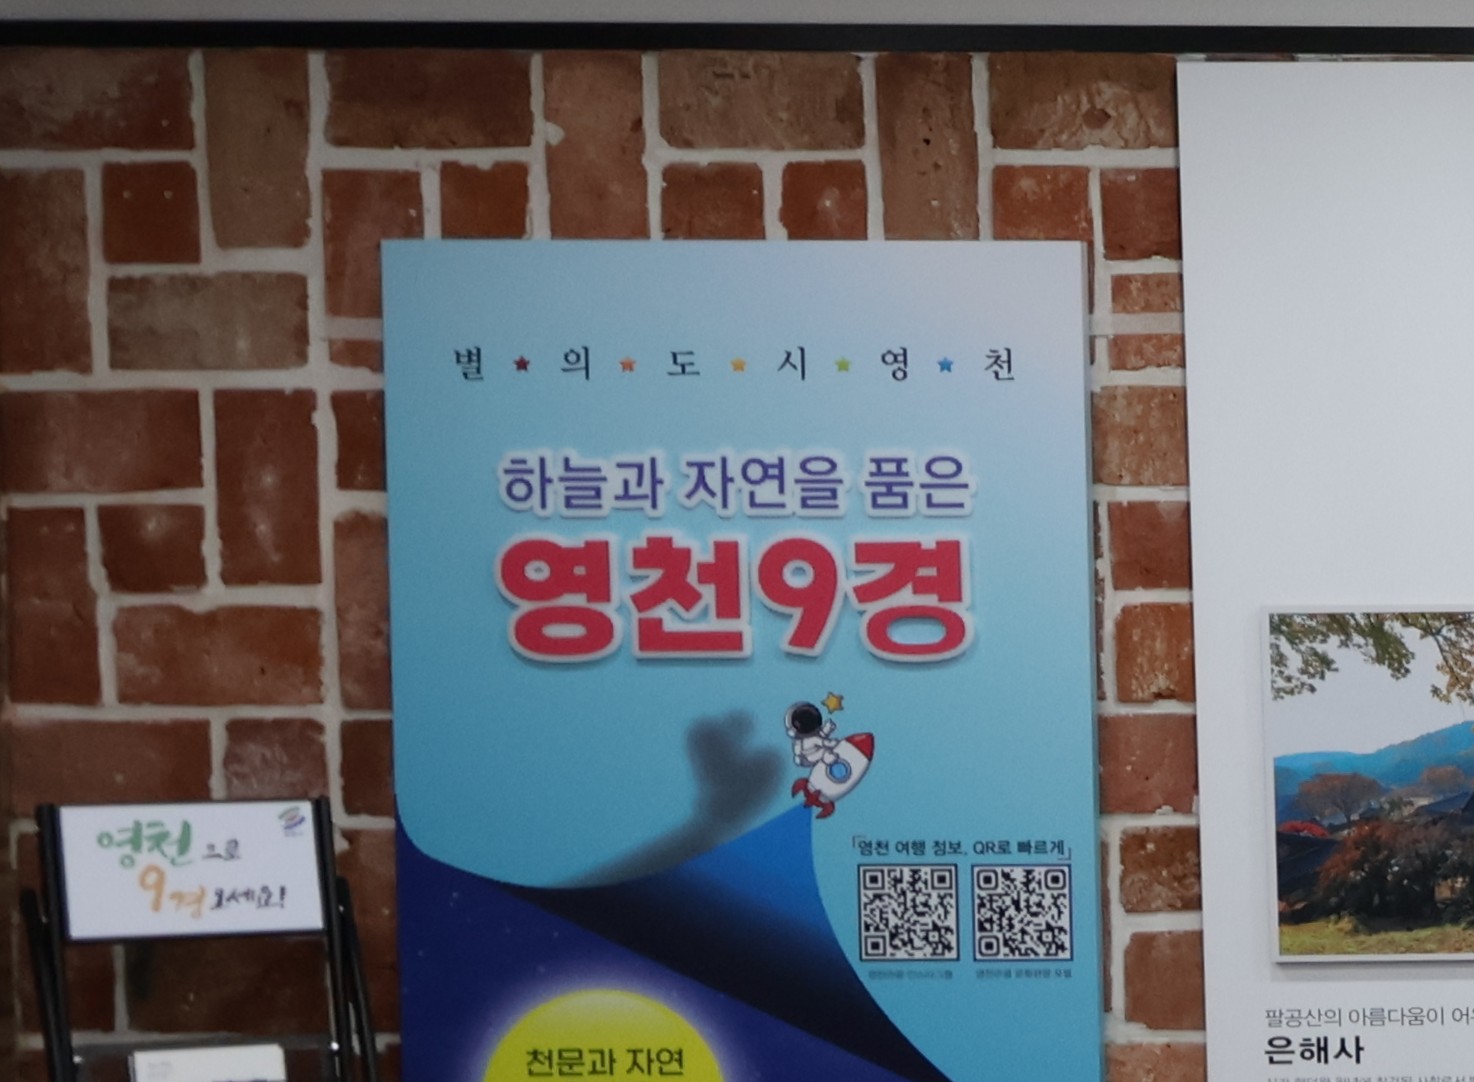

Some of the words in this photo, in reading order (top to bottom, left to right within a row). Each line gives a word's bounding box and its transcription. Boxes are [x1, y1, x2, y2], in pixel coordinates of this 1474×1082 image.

[455, 347, 484, 381] 별
[561, 347, 591, 380] 의
[667, 350, 700, 376] 도
[777, 347, 807, 381] 시
[881, 347, 910, 381] 영
[984, 347, 1016, 381] 천
[503, 456, 664, 510] 하늘과
[684, 456, 843, 510] 자연을
[864, 455, 970, 509] 품은
[500, 536, 967, 656] 영천9경
[97, 820, 194, 869] 영천
[895, 839, 926, 857] 여행
[973, 839, 1011, 856] QR로
[1265, 1007, 1343, 1029] 팔공산의
[1348, 1006, 1445, 1027] 아름다움이
[526, 1047, 617, 1077] 천문과
[626, 1047, 684, 1077] 자연
[1264, 1034, 1365, 1067] 은해사
